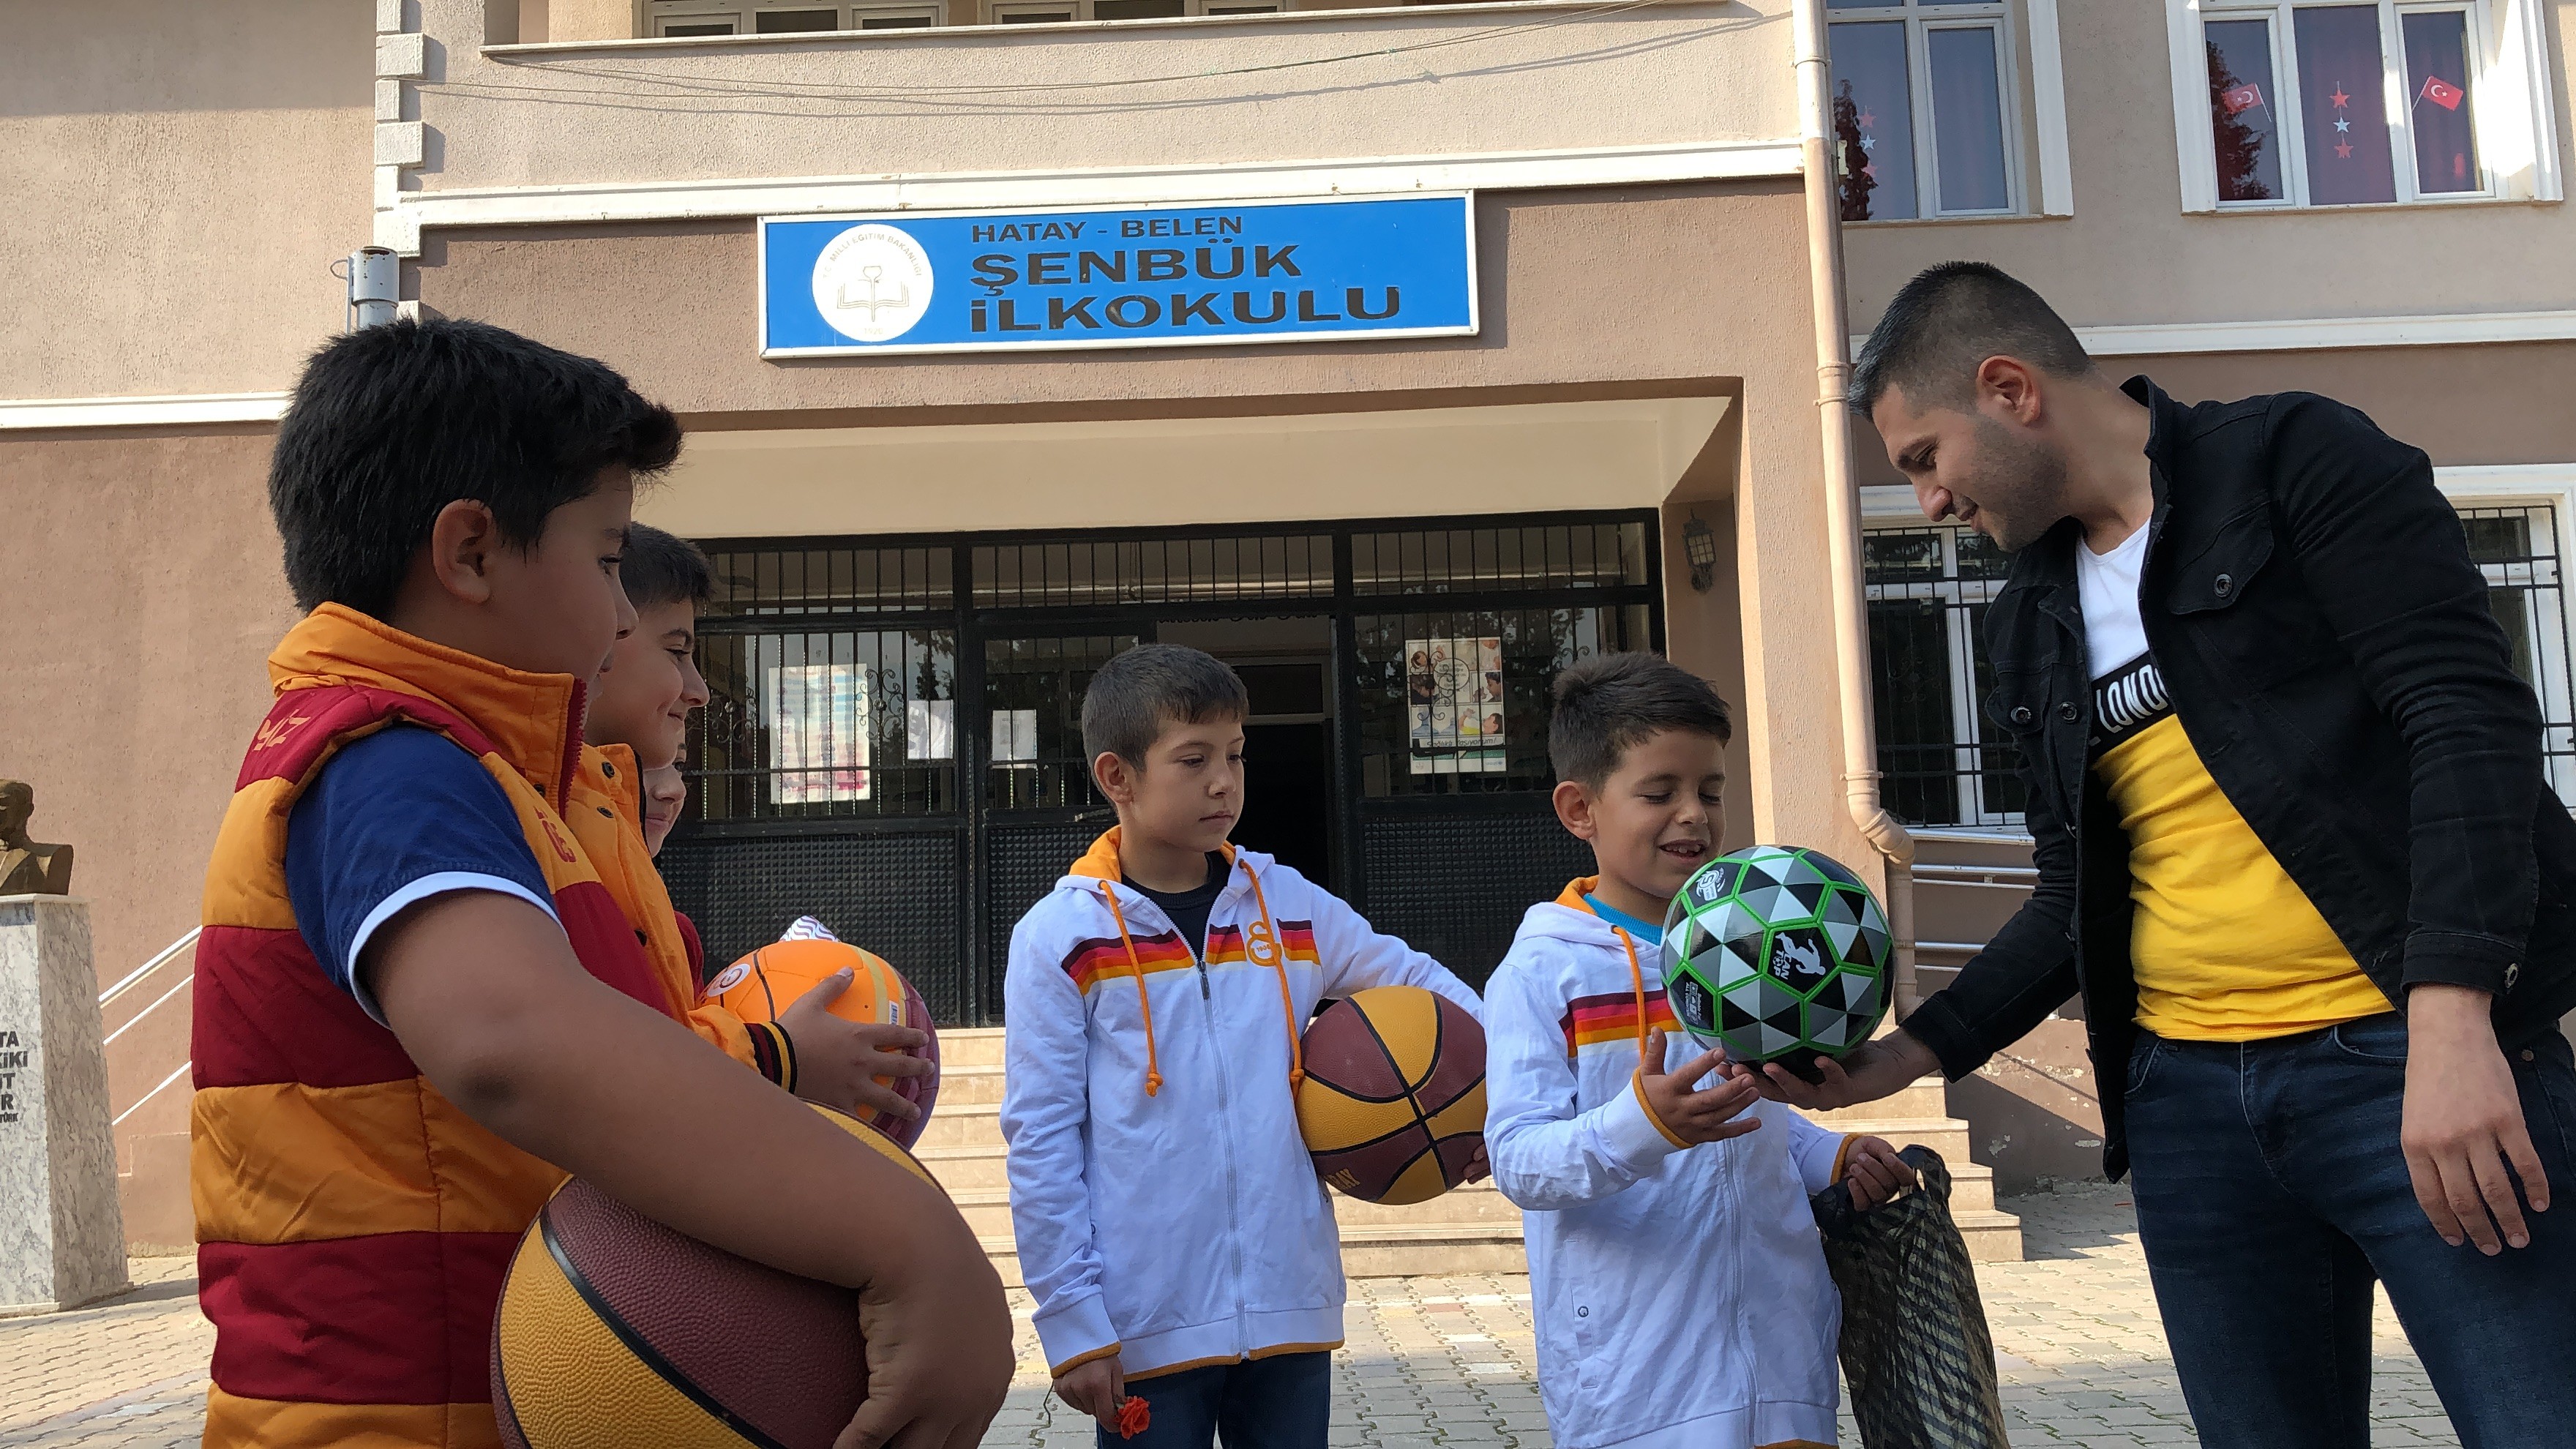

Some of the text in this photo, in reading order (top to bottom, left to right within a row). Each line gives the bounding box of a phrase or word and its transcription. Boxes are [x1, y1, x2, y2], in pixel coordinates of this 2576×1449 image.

[972, 221, 1087, 243] HATAY
[1121, 216, 1242, 238] BELEN
[970, 238, 1302, 296] ŞENBÜK
